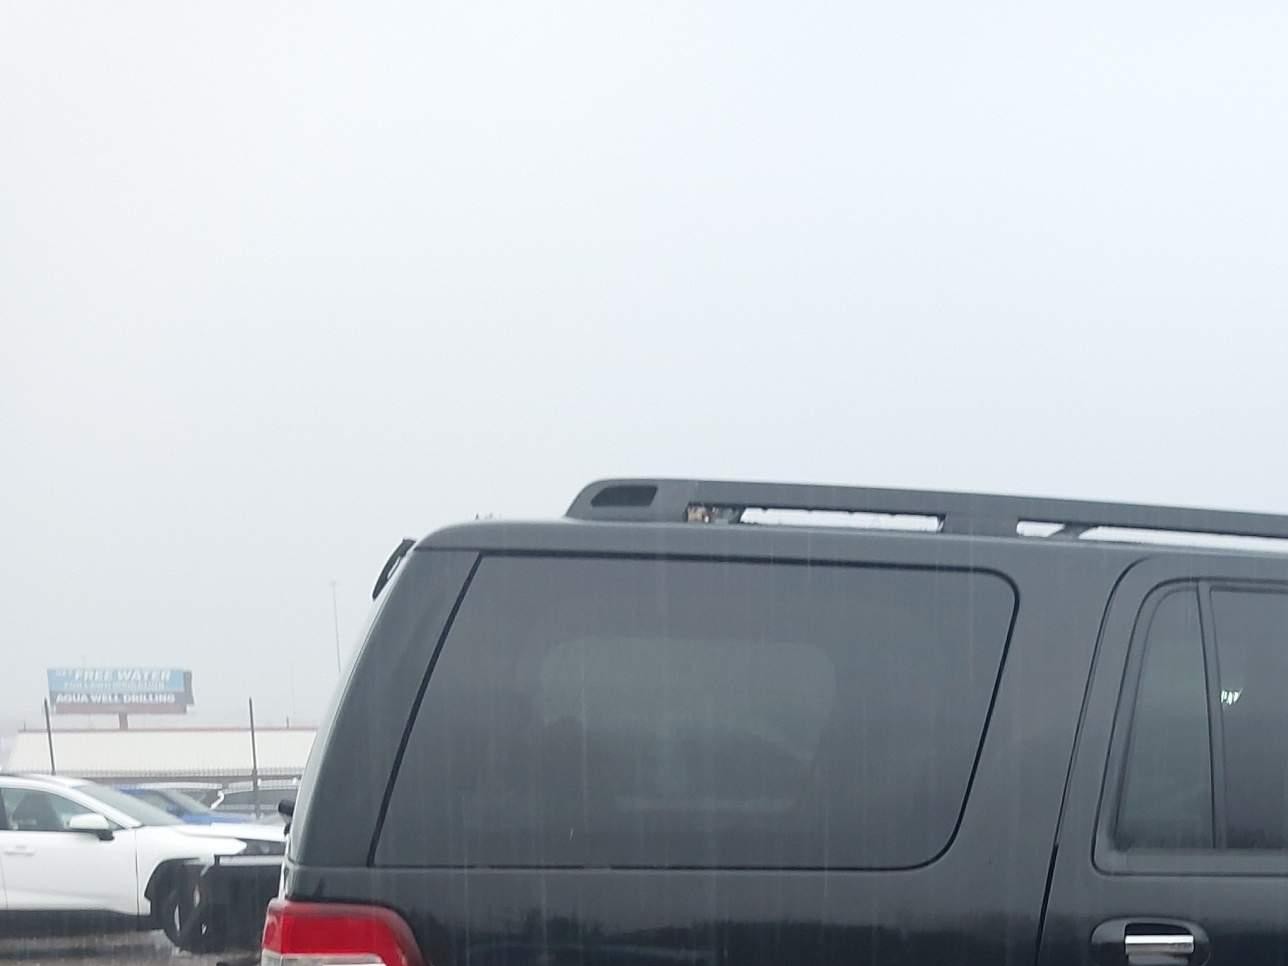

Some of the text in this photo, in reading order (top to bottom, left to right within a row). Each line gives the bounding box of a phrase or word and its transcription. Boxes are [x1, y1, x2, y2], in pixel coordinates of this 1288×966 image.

[74, 669, 113, 681] FREE
[117, 669, 171, 681] WATER
[56, 693, 89, 704] AQUA
[90, 693, 121, 704] WELL
